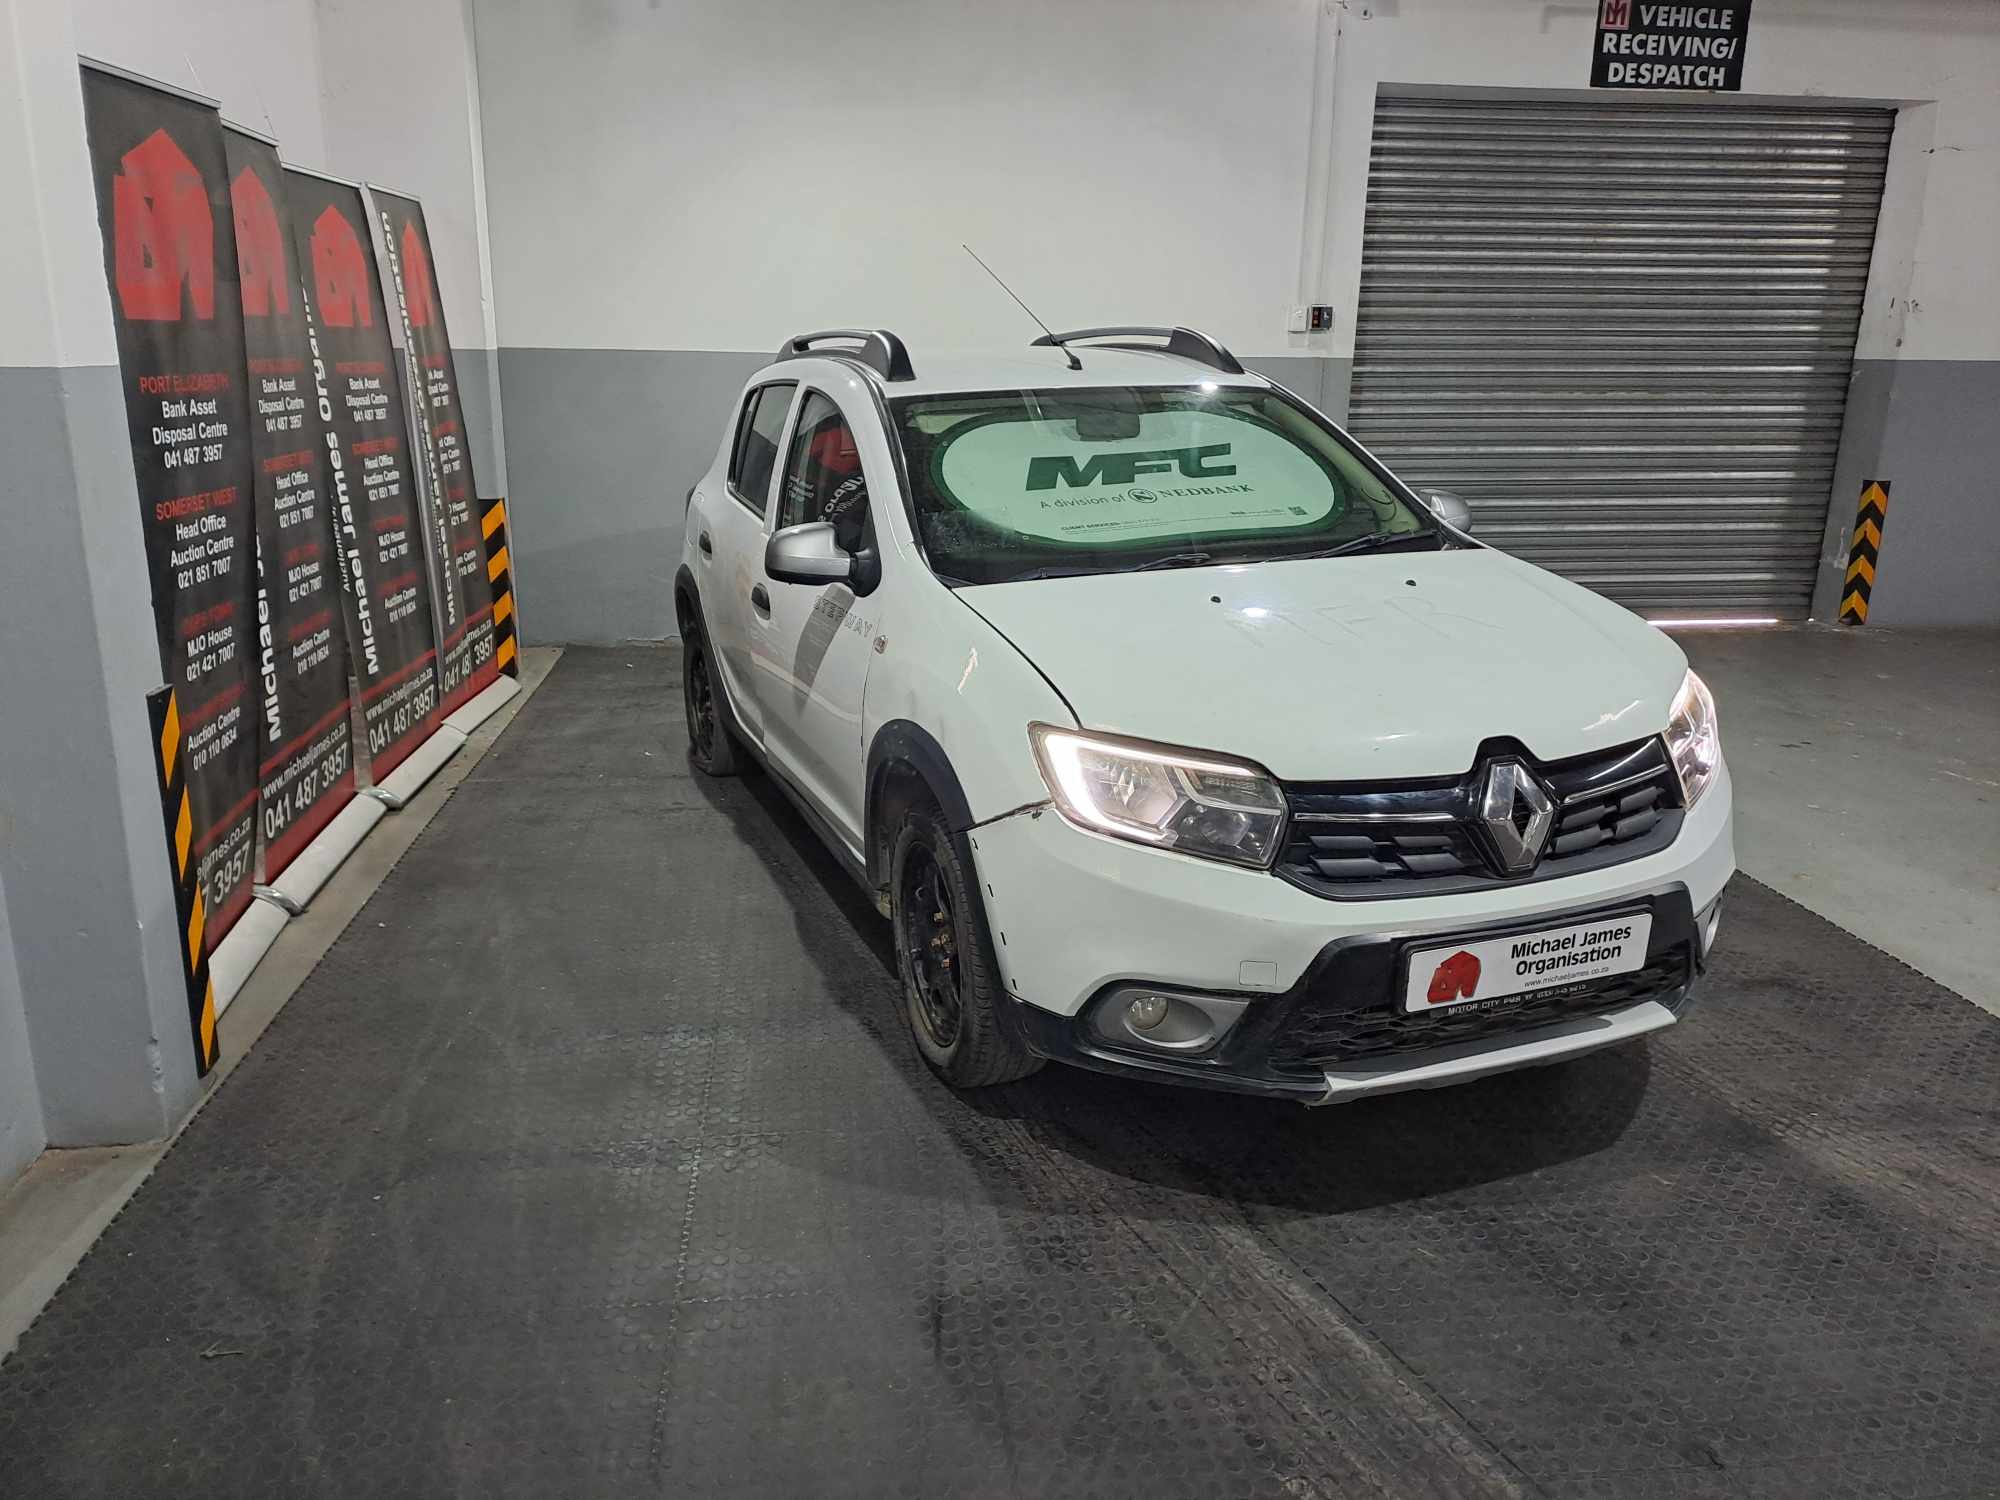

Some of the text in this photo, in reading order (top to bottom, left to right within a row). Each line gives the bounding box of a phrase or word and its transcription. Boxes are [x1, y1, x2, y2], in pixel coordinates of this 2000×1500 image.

[1640, 5, 1734, 30] VEHICLE
[1602, 32, 1739, 60] RECEIVING/
[1608, 62, 1727, 87] DESPATCH
[139, 376, 172, 394] PORT
[162, 398, 217, 418] Bank Asset
[152, 422, 228, 448] Disposal Centre
[164, 444, 223, 468] 041 487 3957
[1024, 442, 1237, 491] MFC
[326, 431, 356, 540] James
[1040, 483, 1255, 510] A division of NEDBANK
[176, 514, 227, 541] Head Office
[170, 541, 206, 567] Auction
[206, 535, 235, 556] Centre
[178, 556, 232, 589] 021 851 7007
[347, 549, 379, 676] Michael
[187, 626, 233, 658] MJO House
[186, 642, 236, 682] 021 421 7007
[444, 663, 459, 692] 041
[474, 633, 494, 664] 3957
[187, 722, 217, 753] Auction
[217, 706, 241, 730] Centre
[369, 684, 435, 754] 041 487 3957
[193, 750, 207, 771] 010
[208, 742, 221, 762] 110
[263, 722, 346, 799] www.michaeljames.co.za
[266, 742, 348, 839] 041 487 3957
[214, 840, 250, 904] 3957
[1511, 926, 1632, 960] Michael James
[1515, 943, 1622, 976] Organisation
